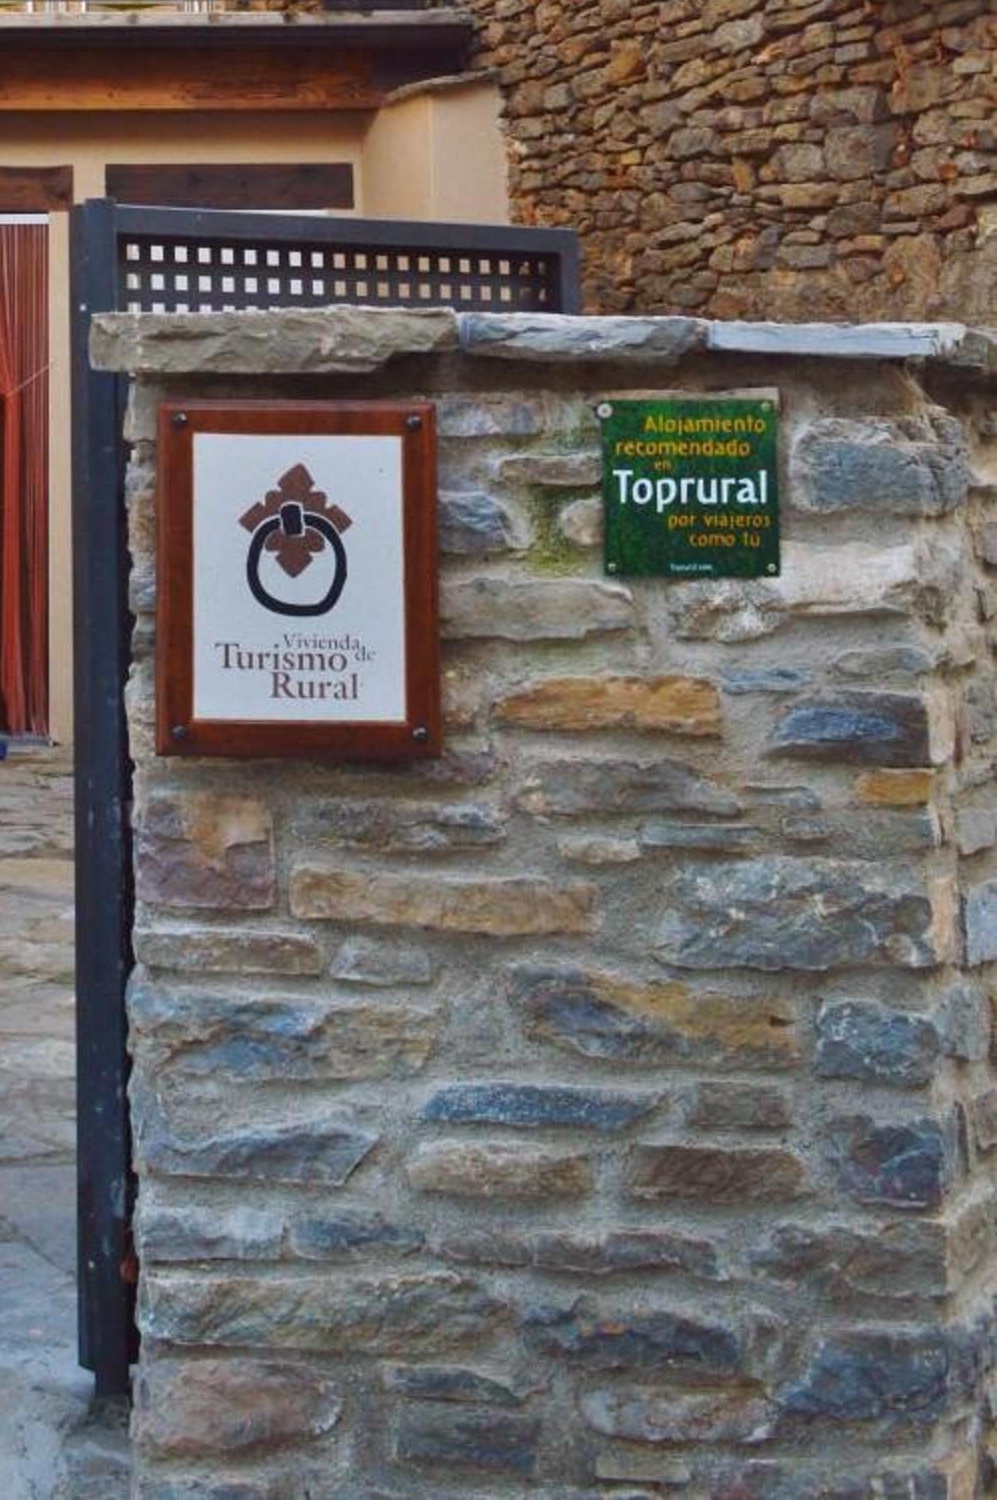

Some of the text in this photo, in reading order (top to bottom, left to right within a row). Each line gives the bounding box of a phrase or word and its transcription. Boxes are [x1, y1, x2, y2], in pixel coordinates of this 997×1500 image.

[644, 415, 766, 435] Alojamiento
[616, 438, 751, 456] recomendado
[612, 469, 767, 513] Toprural
[668, 512, 771, 531] por viajeros
[689, 534, 736, 548] como
[284, 634, 361, 650] Vivienda
[215, 643, 348, 672] Turismo
[355, 646, 376, 661] de
[270, 672, 359, 700] Rural
